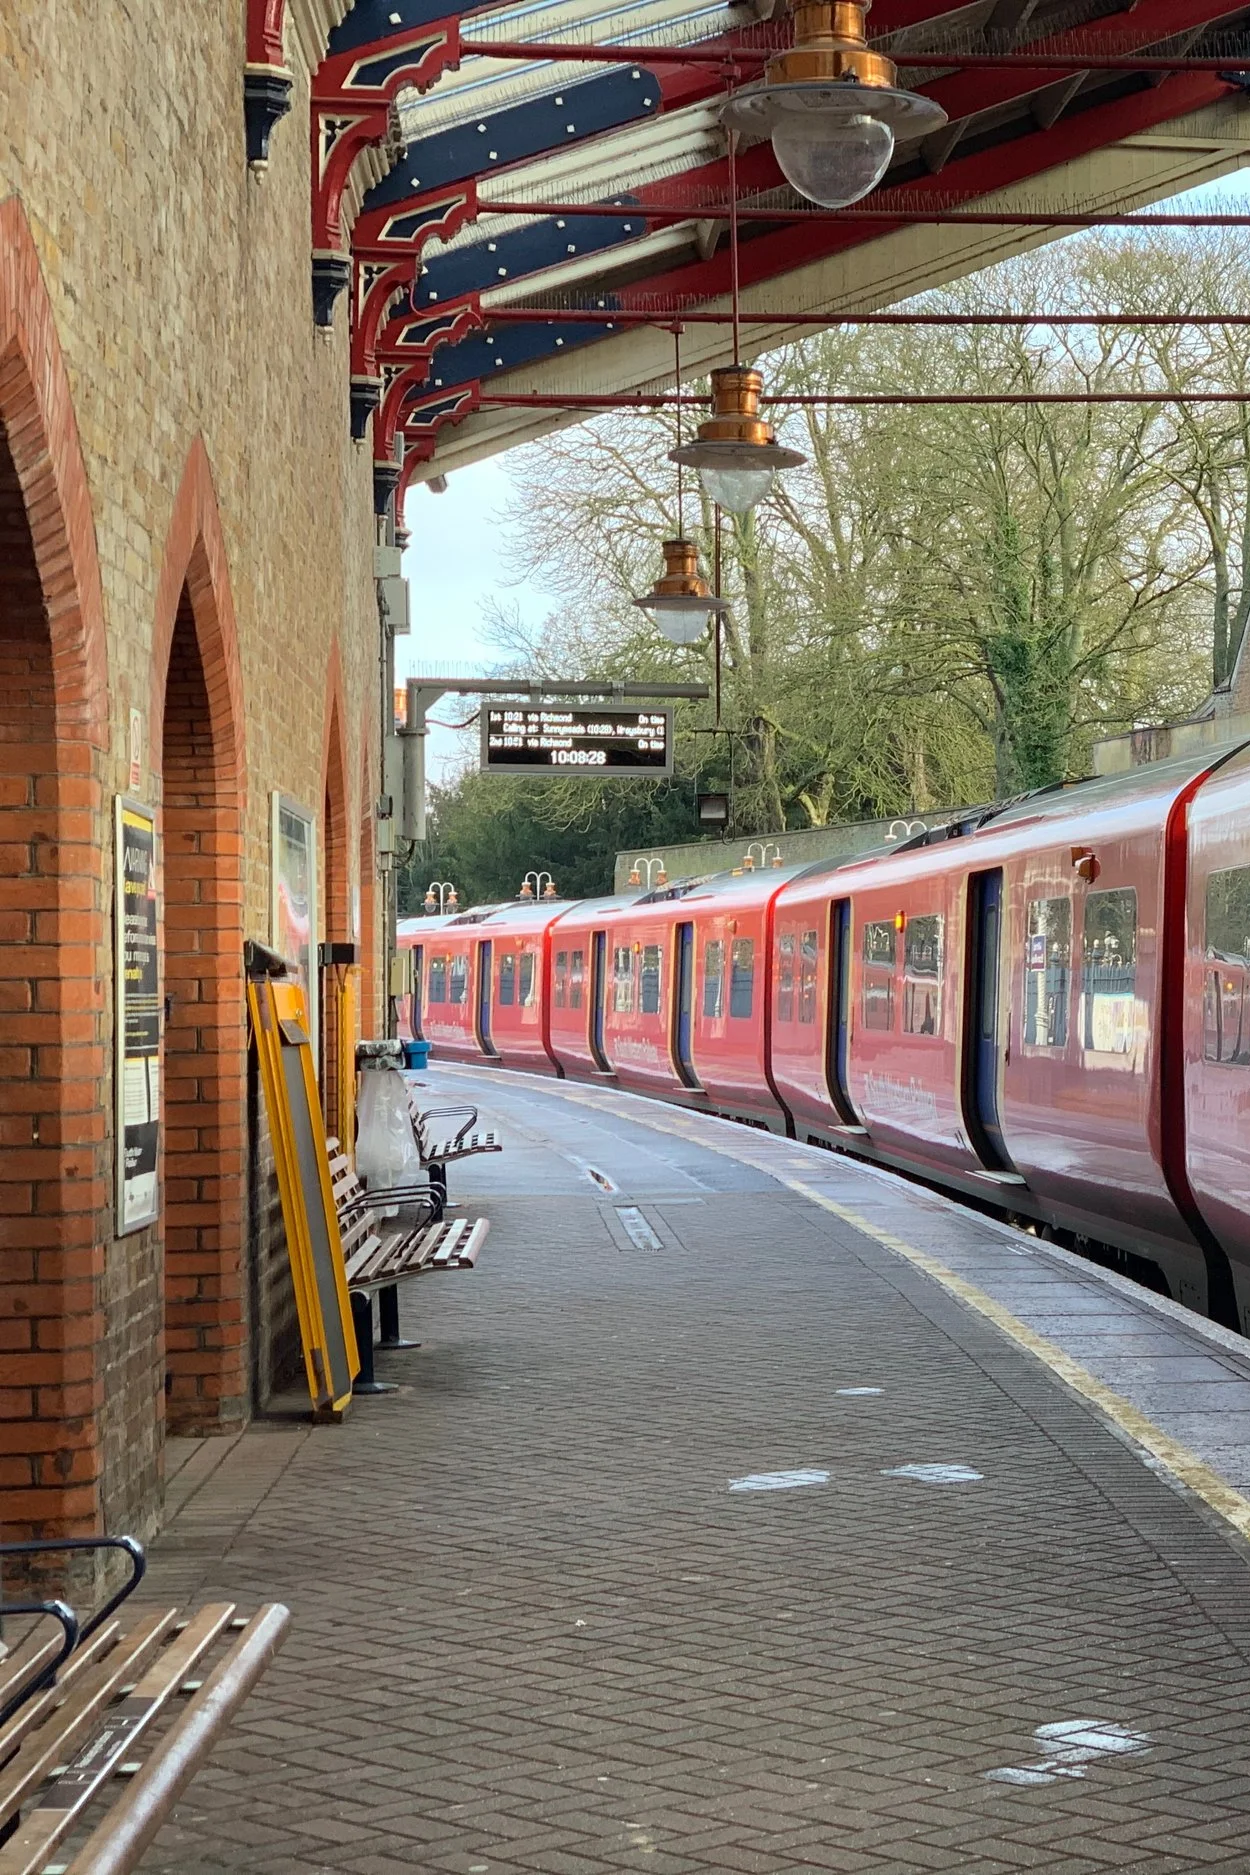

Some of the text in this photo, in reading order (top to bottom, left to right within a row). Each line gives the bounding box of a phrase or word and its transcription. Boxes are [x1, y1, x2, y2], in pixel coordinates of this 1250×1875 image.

[527, 712, 539, 722] via
[638, 714, 649, 724] On
[527, 737, 539, 747] via
[638, 739, 649, 749] On
[551, 750, 607, 765] 10:08:28
